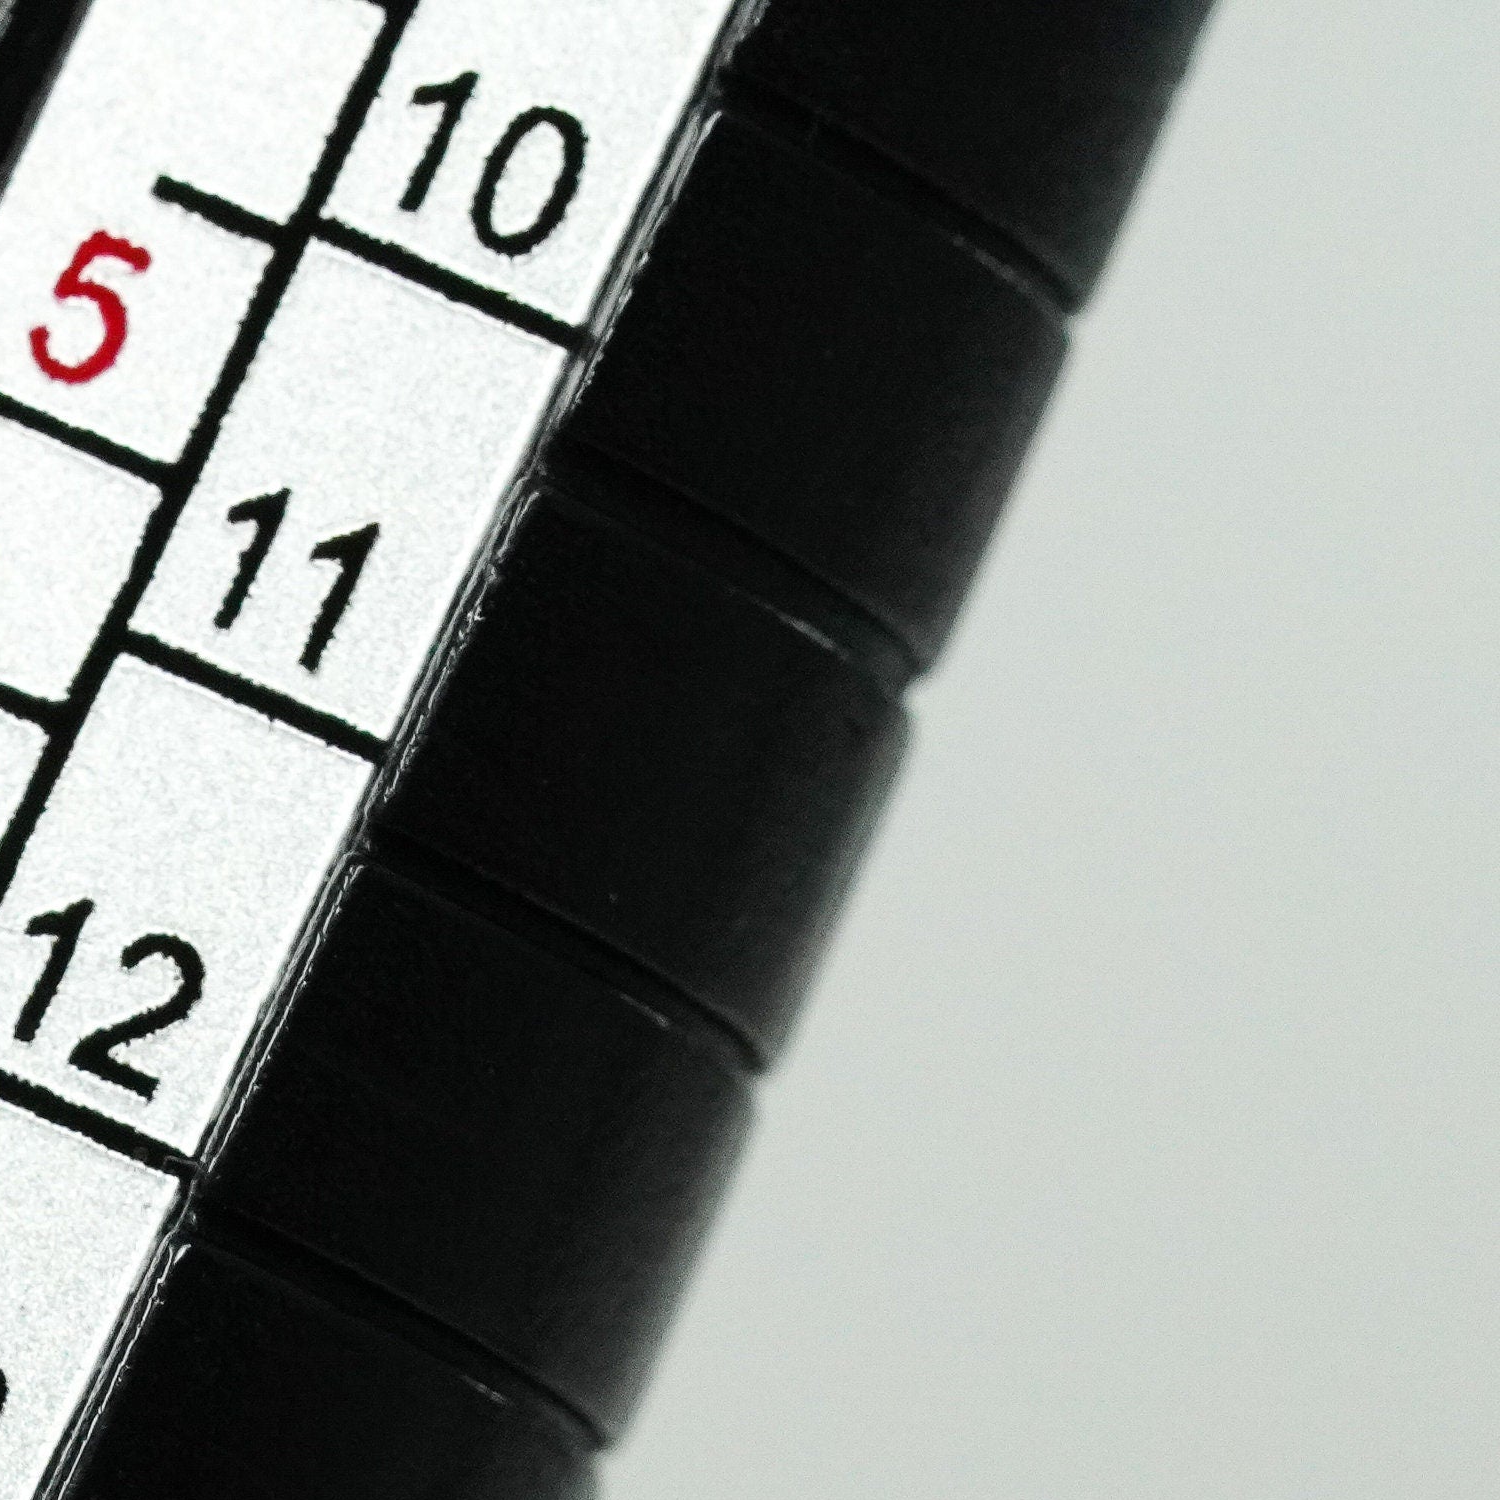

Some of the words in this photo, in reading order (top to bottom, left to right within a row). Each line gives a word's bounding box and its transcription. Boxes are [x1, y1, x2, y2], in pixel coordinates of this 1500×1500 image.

[399, 71, 589, 259] 10
[29, 230, 151, 385] 5
[214, 488, 379, 673] 11
[13, 898, 206, 1102] 12
